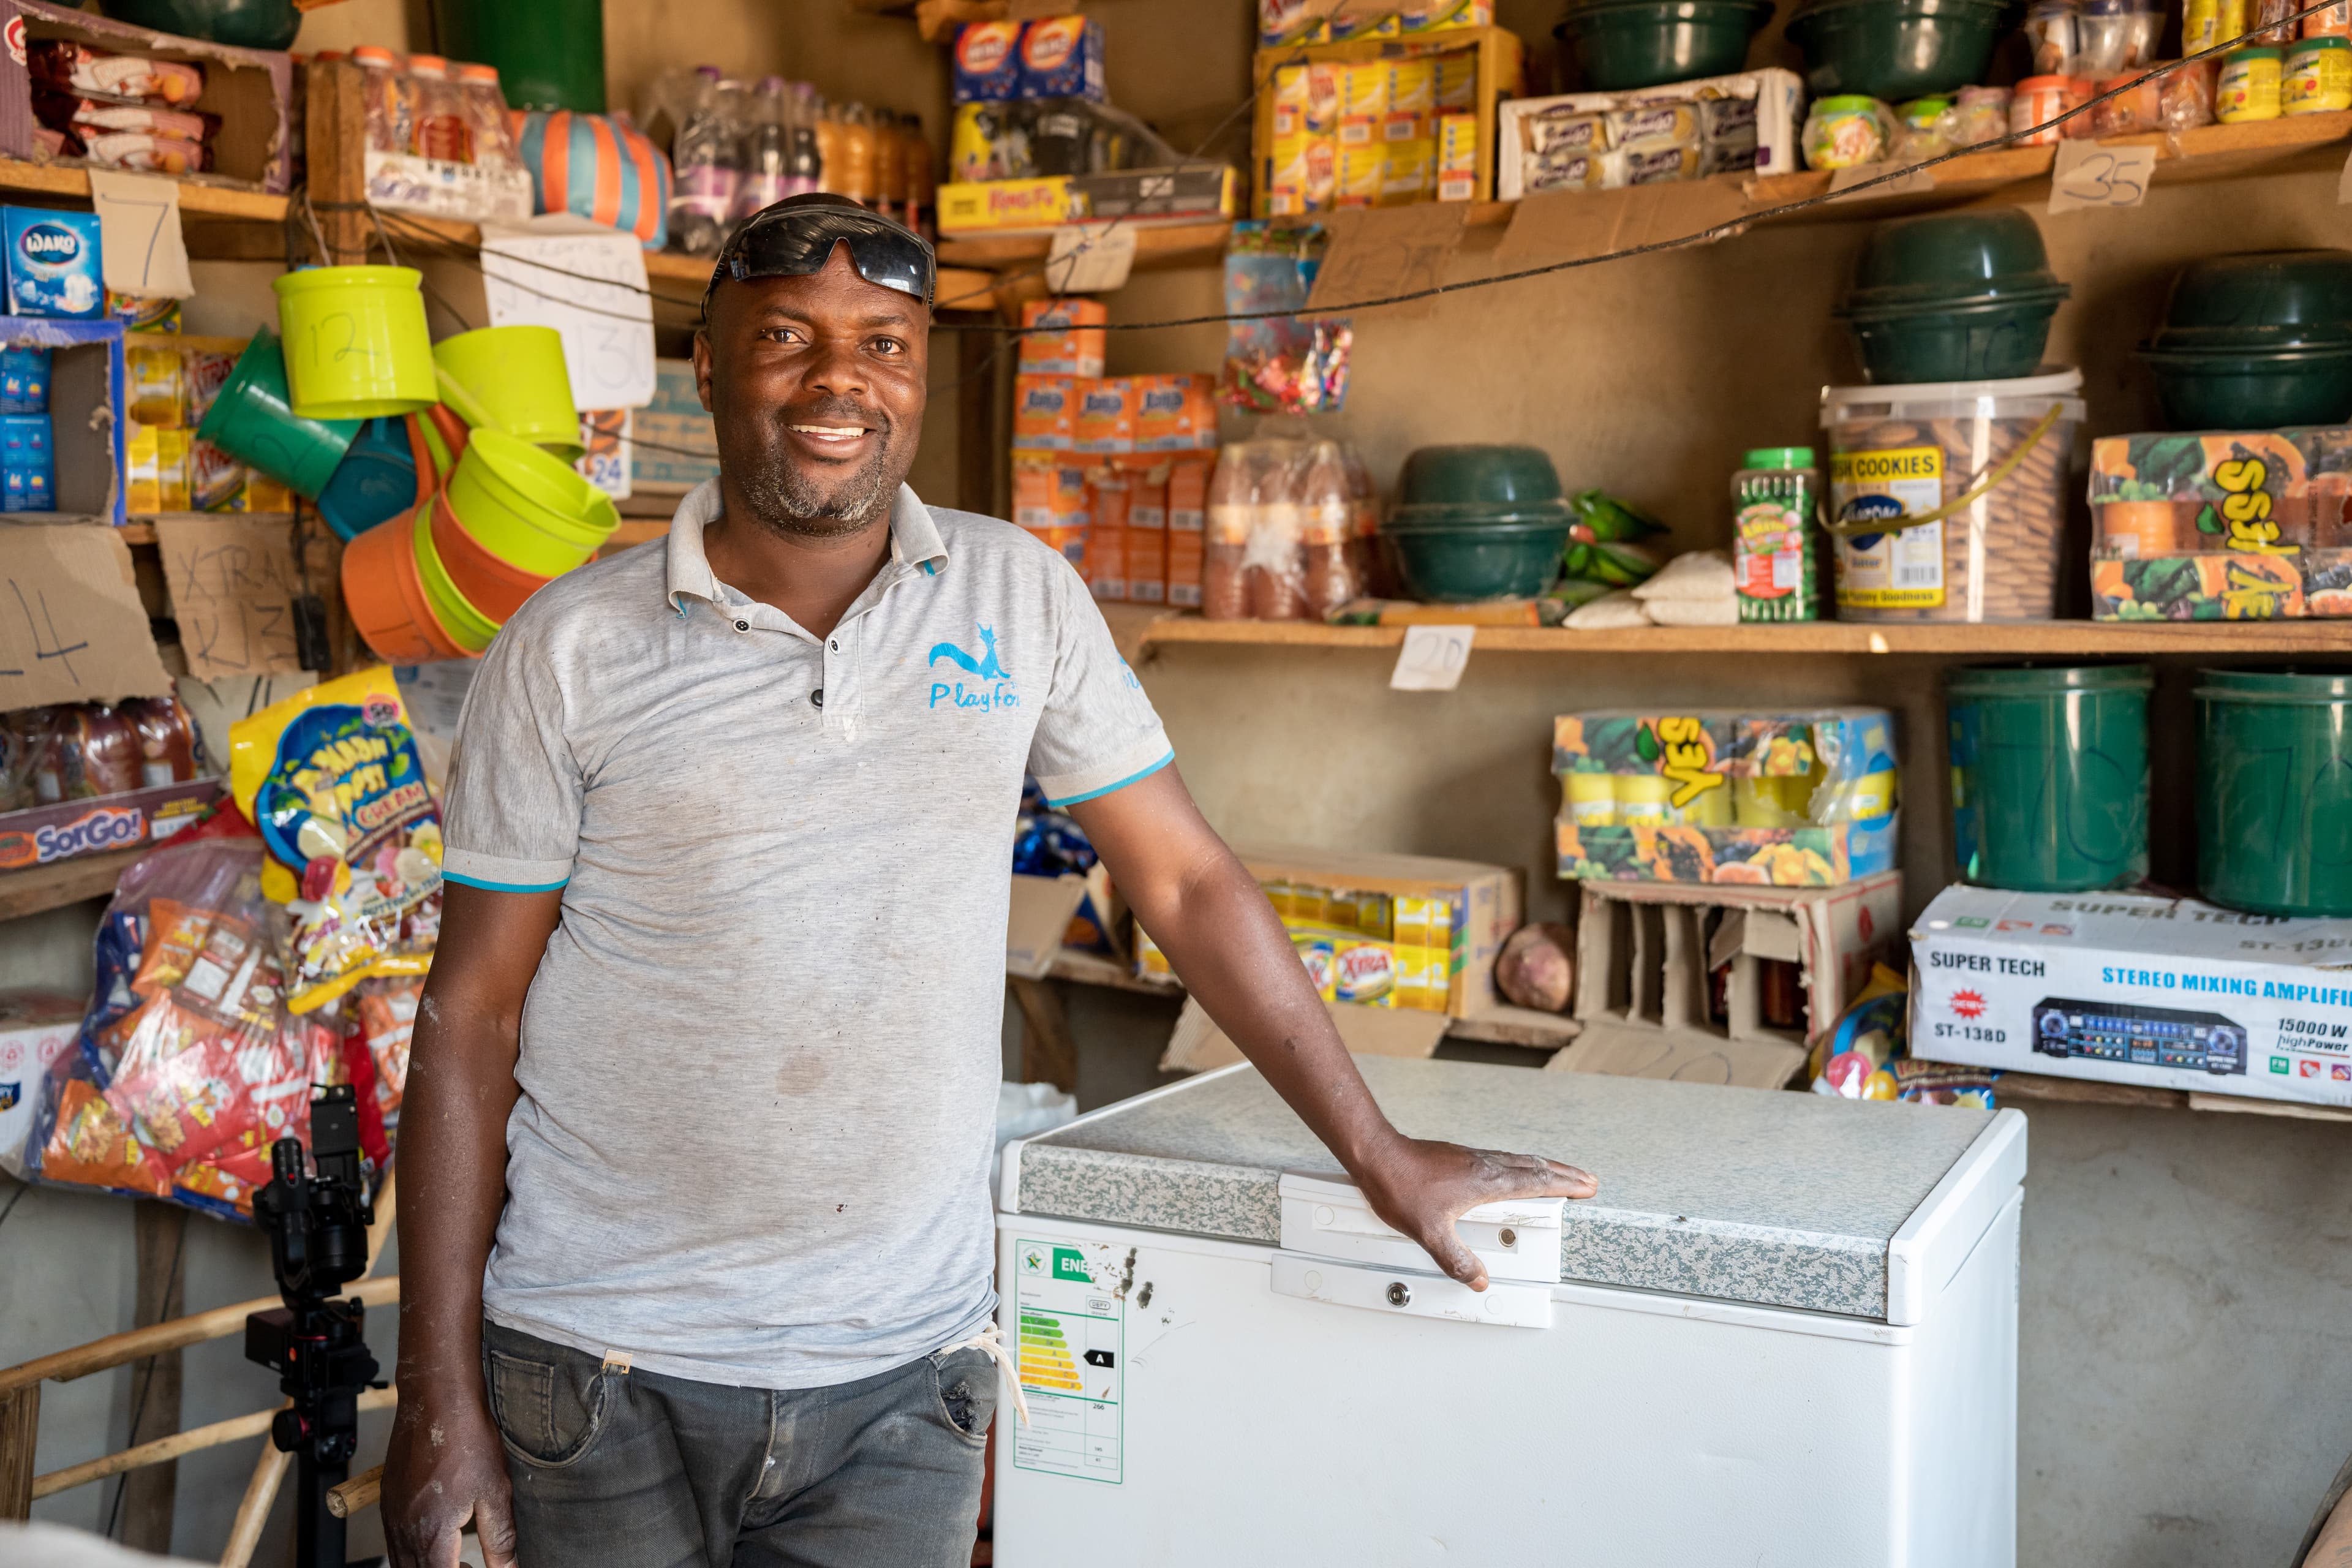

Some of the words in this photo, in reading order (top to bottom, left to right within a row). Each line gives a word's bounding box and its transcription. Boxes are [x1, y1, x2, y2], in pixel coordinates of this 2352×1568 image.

[2063, 153, 2142, 206] 35
[100, 192, 170, 287] 7
[309, 311, 381, 368] 12
[592, 457, 623, 484] 24
[1856, 455, 1935, 477] COOKIES
[356, 782, 426, 827] CREAM
[36, 809, 141, 861] SorGo!
[2049, 899, 2178, 921] SUPER
[1931, 951, 1991, 972] SUPER
[1997, 957, 2045, 978] TECH
[2102, 967, 2176, 989] STEREO
[2182, 974, 2257, 997] MIXING
[1934, 1022, 2006, 1042] ST-138D
[2278, 1017, 2328, 1036] 15000
[2330, 1025, 2347, 1038] W
[2276, 1033, 2349, 1052] highPower
[2272, 1059, 2287, 1068] FM
[1095, 1354, 1104, 1364] A
